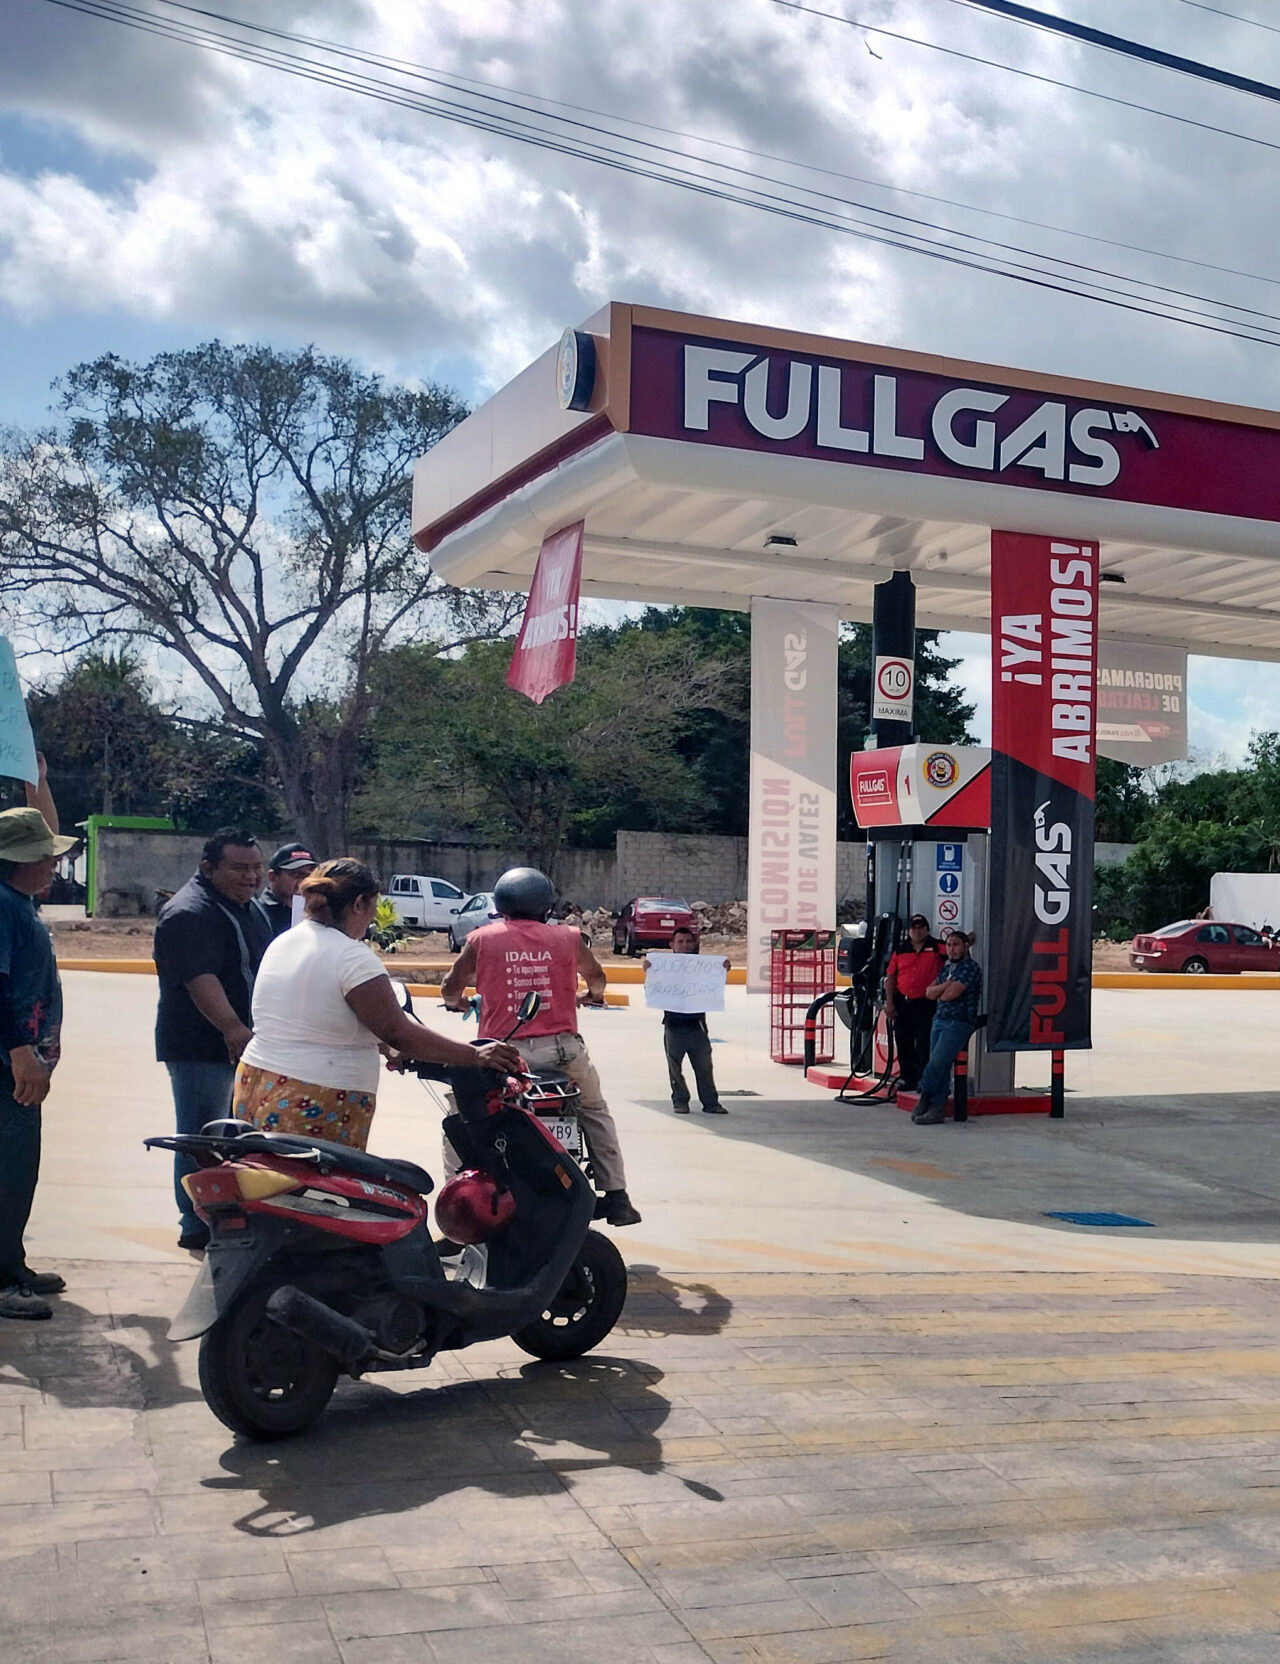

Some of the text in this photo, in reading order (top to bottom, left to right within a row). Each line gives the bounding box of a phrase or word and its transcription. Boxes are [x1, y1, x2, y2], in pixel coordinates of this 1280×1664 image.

[1001, 614, 1042, 685] ¡YA
[1051, 543, 1093, 763] ABRIMOS!
[885, 670, 905, 687] 10
[904, 775, 911, 796] 1
[505, 951, 552, 962] IDALIA
